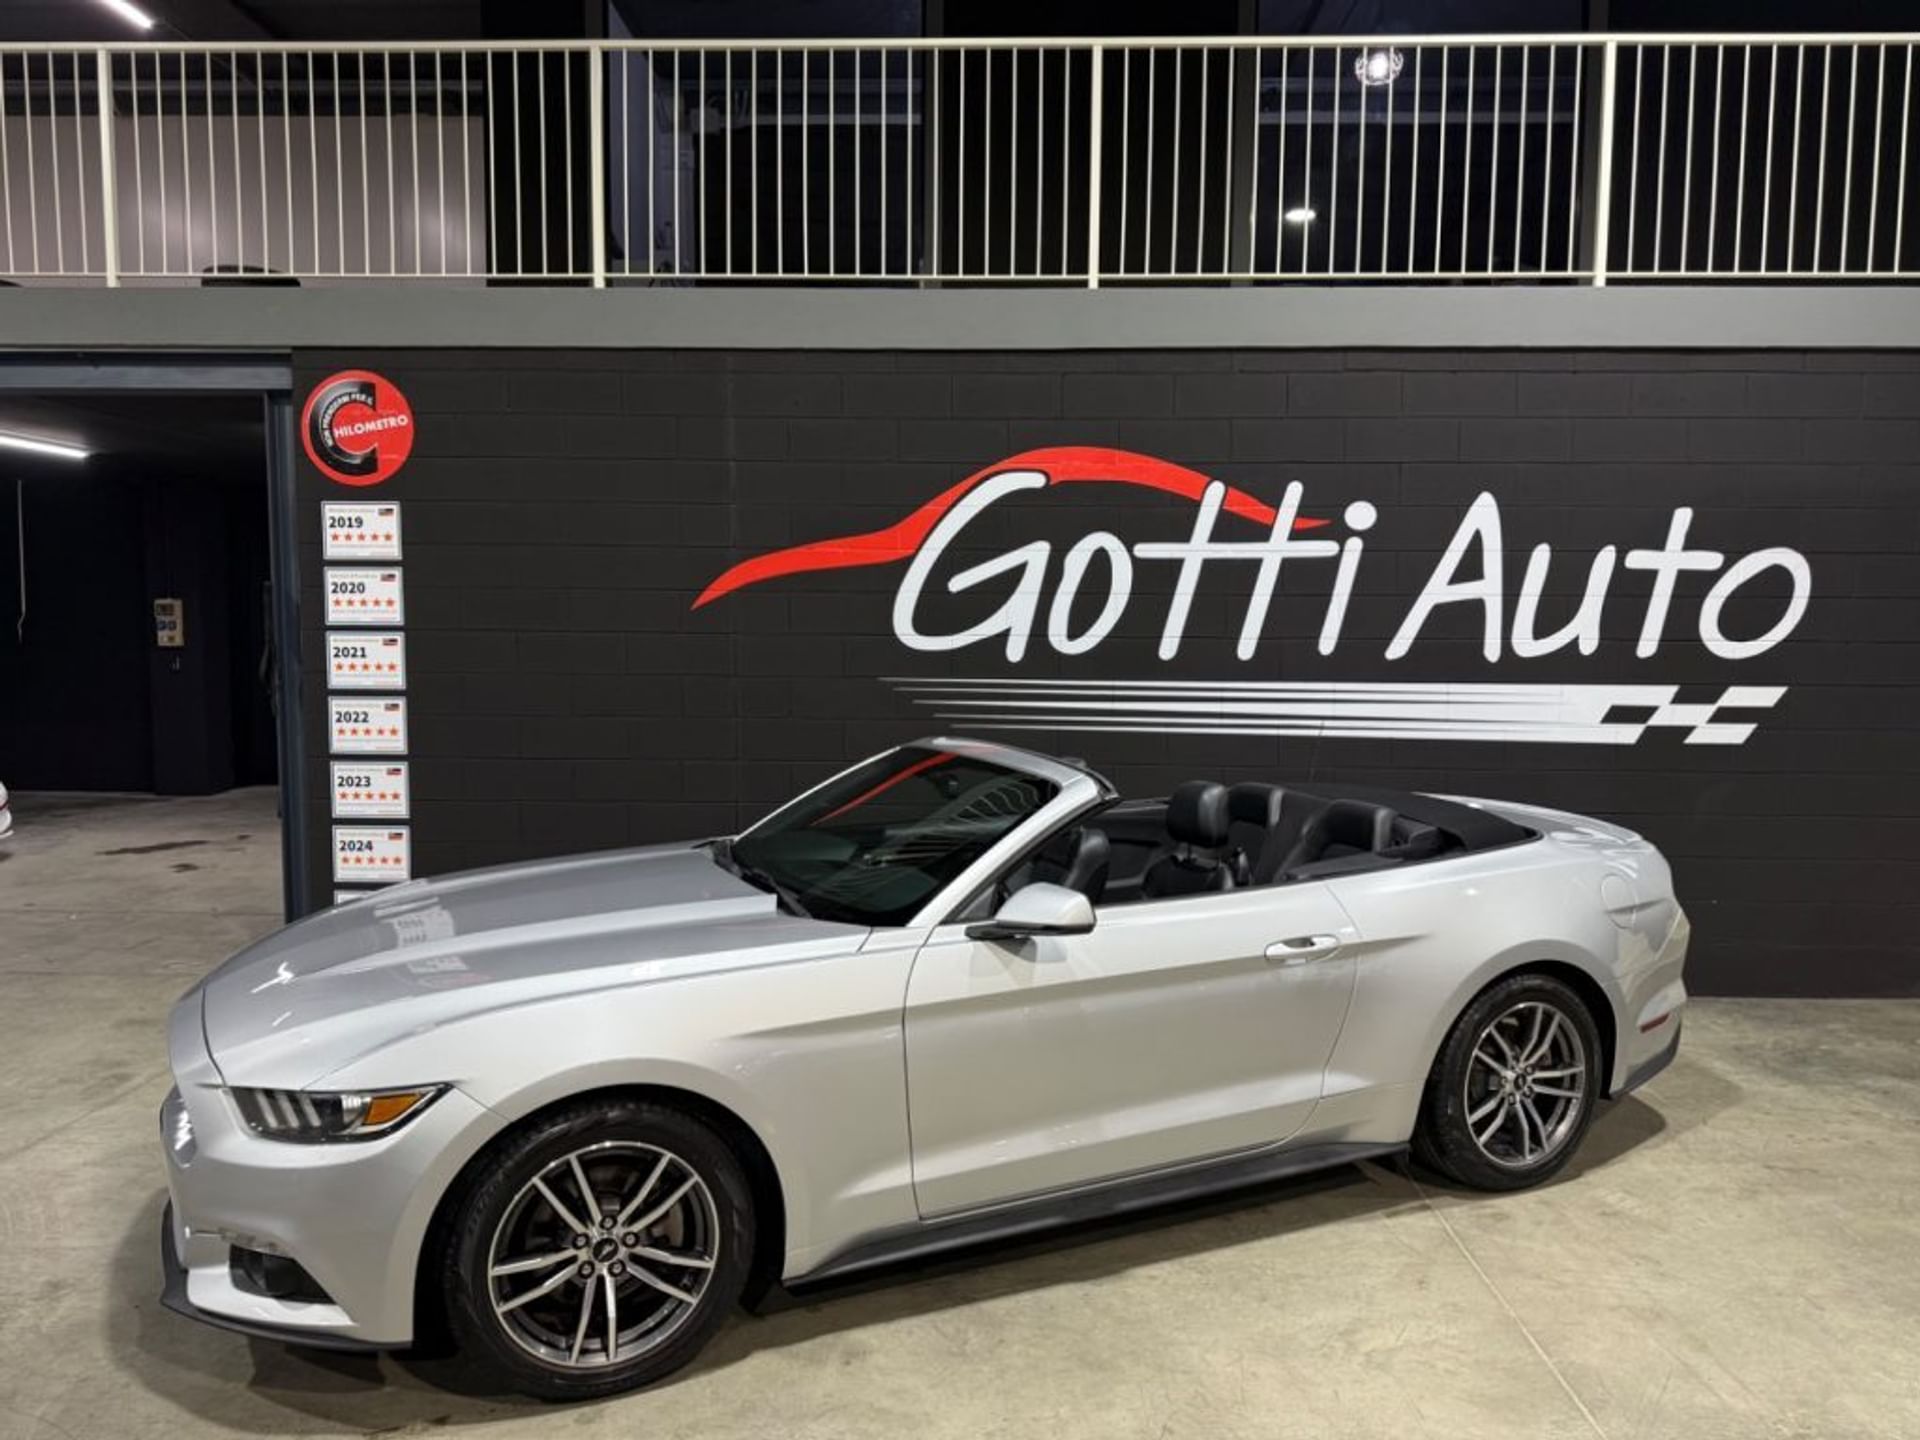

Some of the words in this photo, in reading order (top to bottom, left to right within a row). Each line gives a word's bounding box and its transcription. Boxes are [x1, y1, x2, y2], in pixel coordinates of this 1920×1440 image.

[329, 516, 364, 528] 2019
[892, 471, 1379, 663] Gotti
[1385, 491, 1812, 662] Auto
[331, 582, 365, 594] 2020
[333, 646, 367, 658] 2021
[335, 711, 369, 723] 2022
[337, 776, 371, 788] 2023
[340, 840, 374, 852] 2024
